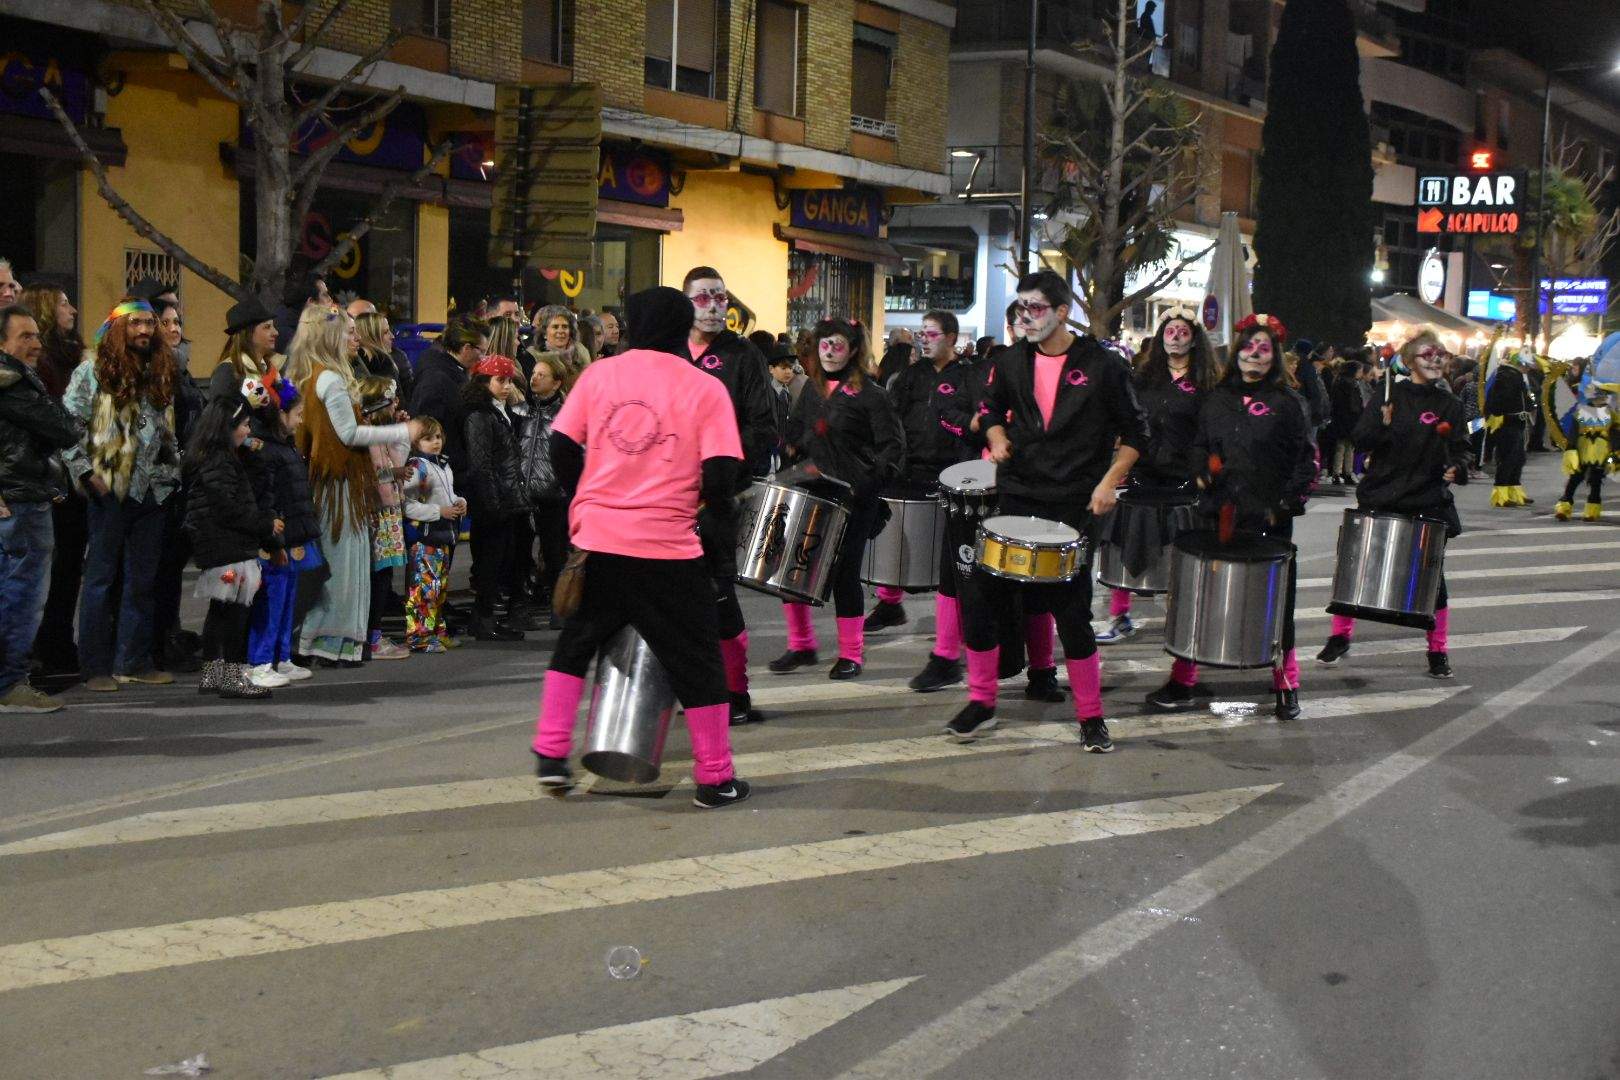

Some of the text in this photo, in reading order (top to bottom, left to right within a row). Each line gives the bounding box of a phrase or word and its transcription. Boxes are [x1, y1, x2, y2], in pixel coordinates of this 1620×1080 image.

[1452, 176, 1515, 205] BAR
[803, 189, 870, 227] GANGA
[1447, 212, 1518, 233] ACAPULCO
